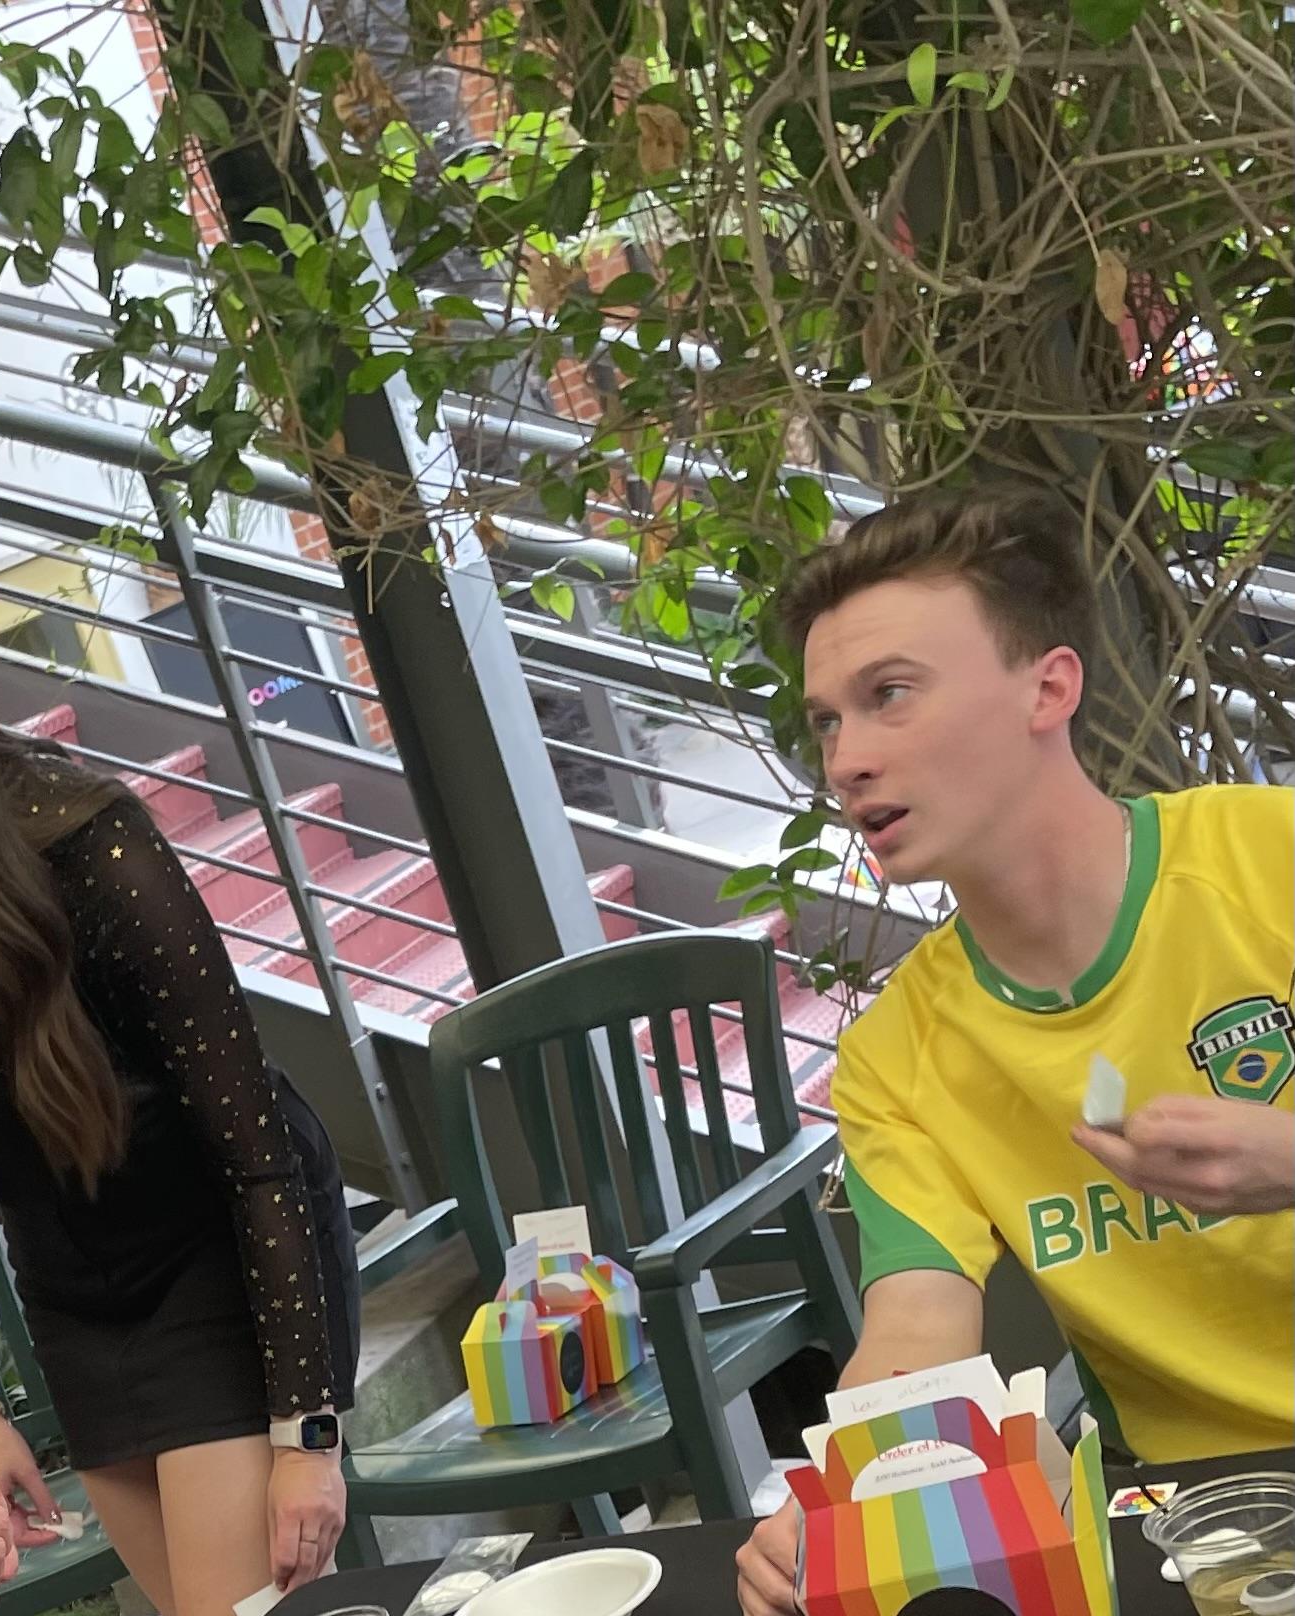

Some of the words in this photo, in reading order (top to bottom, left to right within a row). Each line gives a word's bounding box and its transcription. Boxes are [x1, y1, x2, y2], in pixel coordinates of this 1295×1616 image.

[1203, 1015, 1278, 1056] BRAZIL
[1027, 1182, 1234, 1271] BRA
[878, 1443, 914, 1463] Order
[916, 1440, 932, 1455] of
